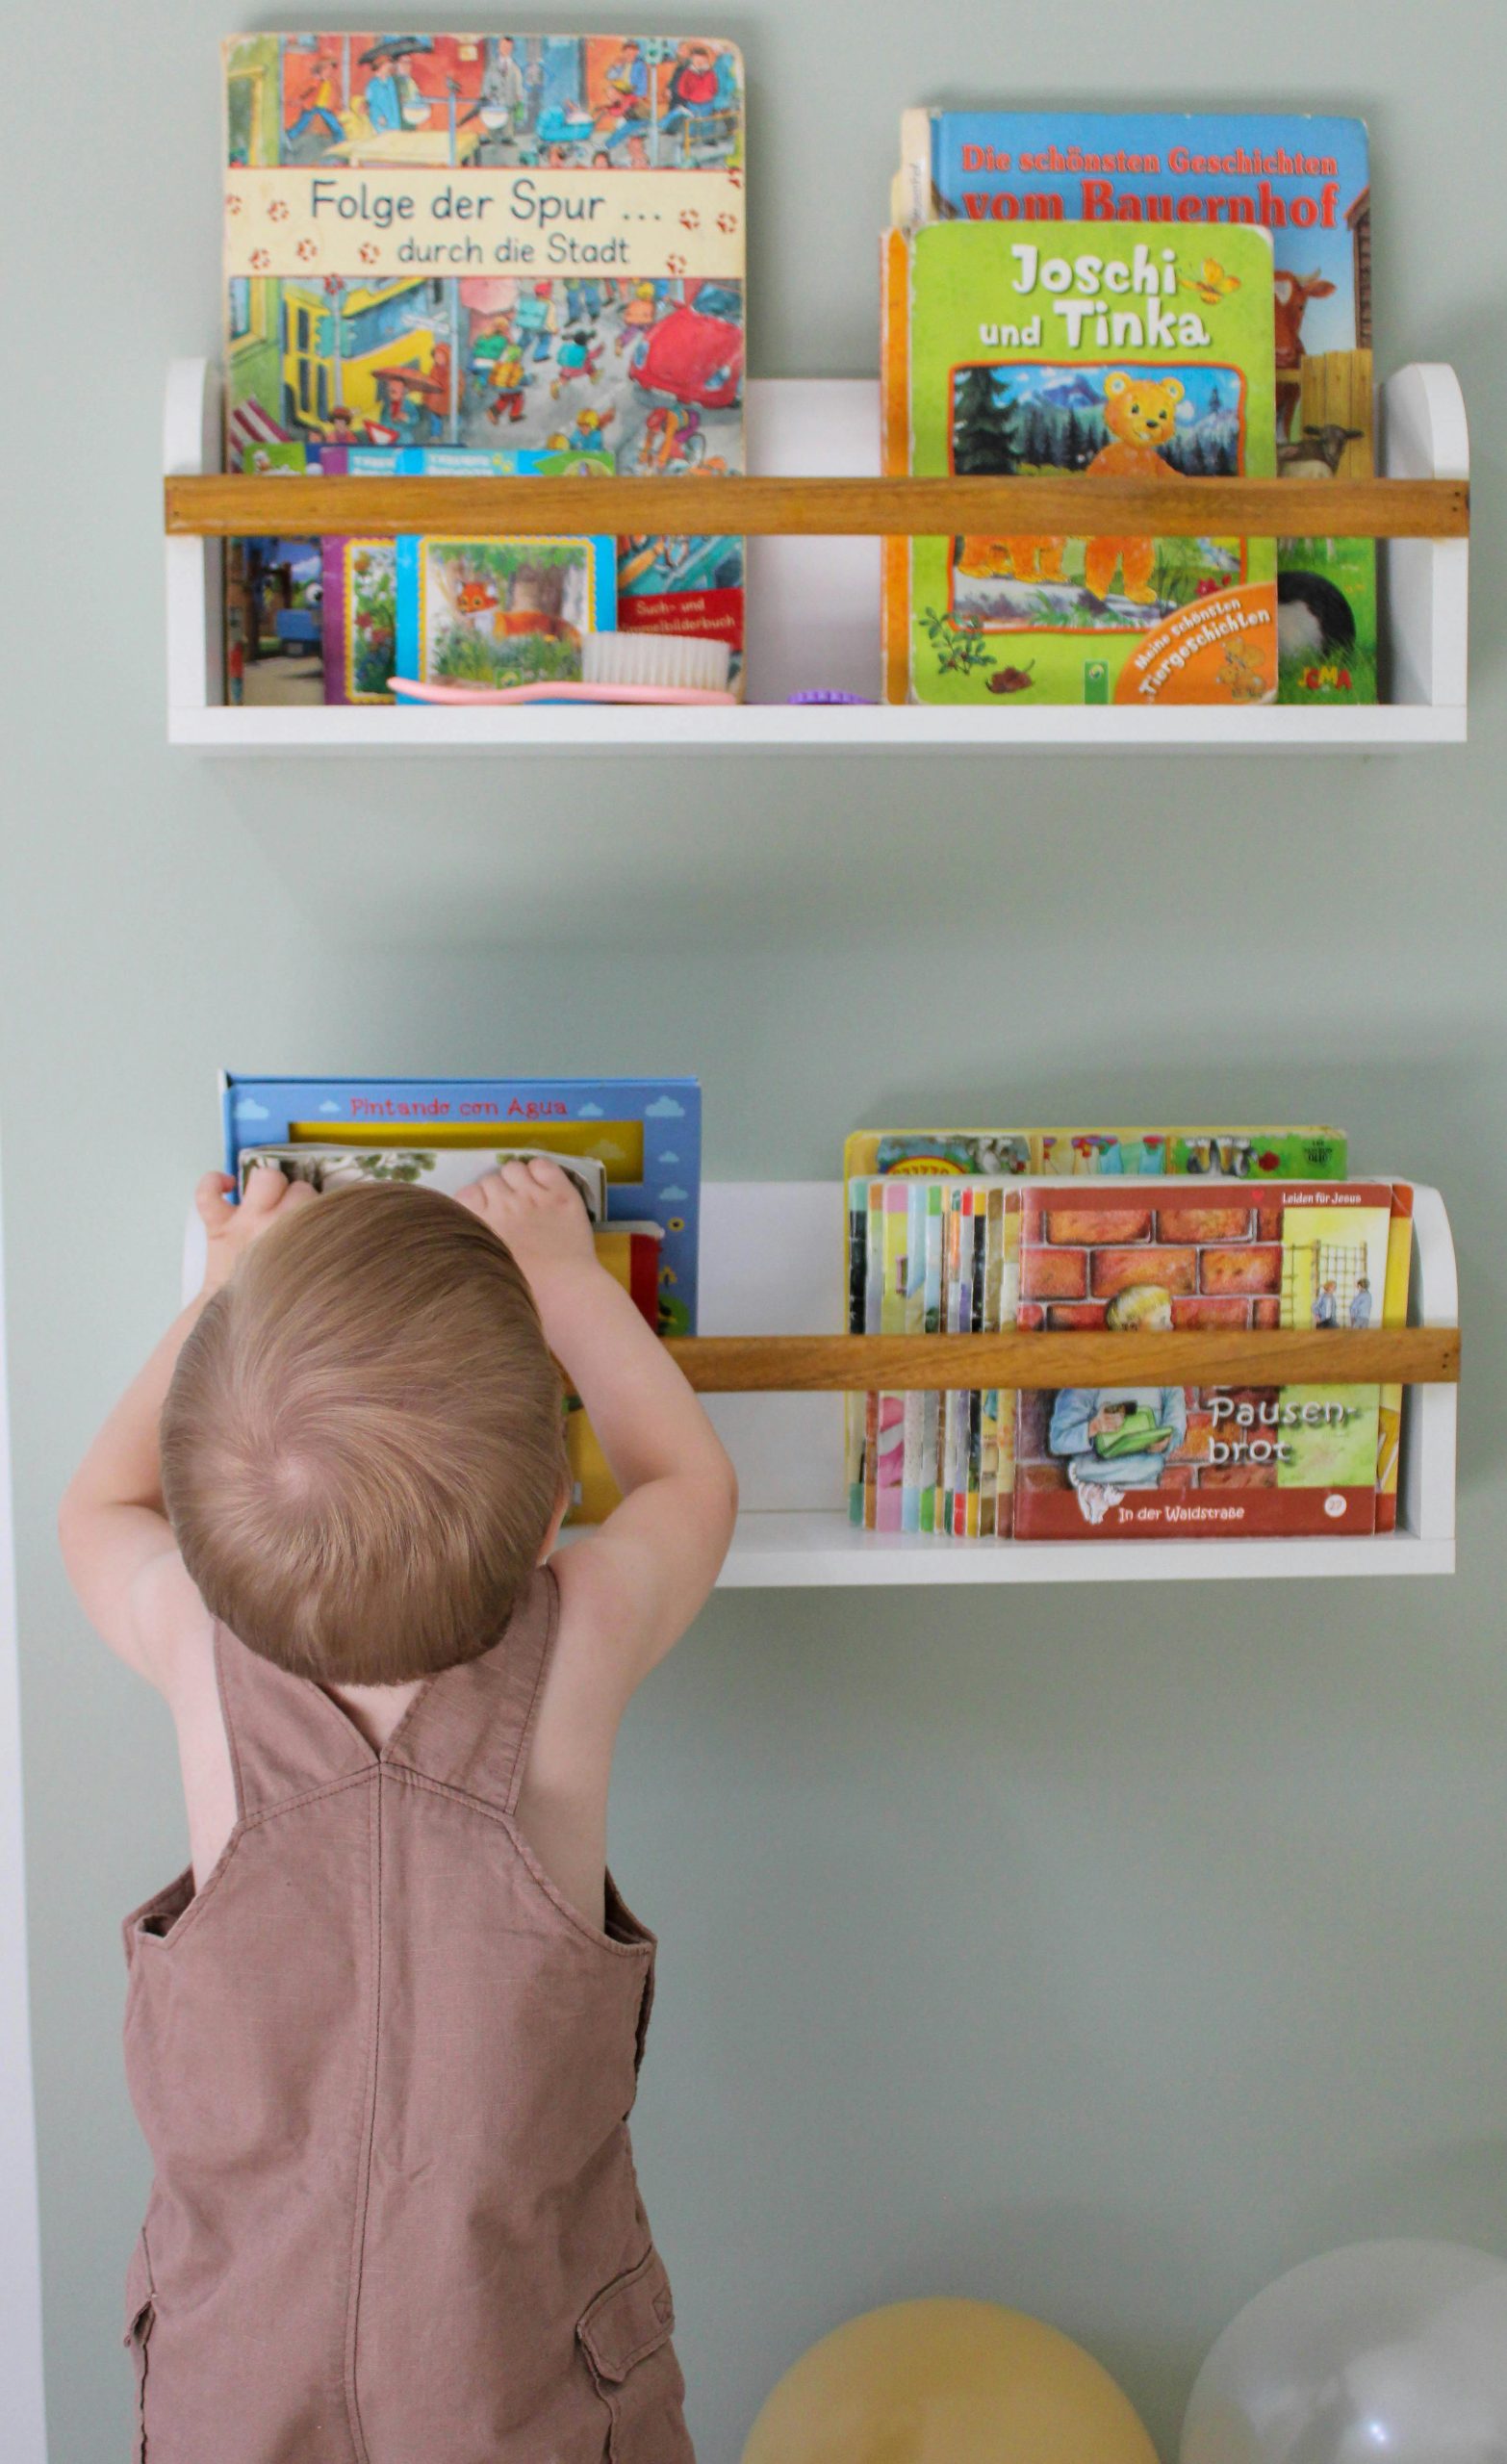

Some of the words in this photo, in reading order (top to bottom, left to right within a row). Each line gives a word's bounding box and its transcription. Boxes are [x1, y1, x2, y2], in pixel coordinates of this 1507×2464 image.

[961, 145, 1010, 172] Die
[1019, 145, 1161, 173] schönsten
[1167, 146, 1338, 175] Geschichten
[312, 179, 414, 227] Folge
[431, 186, 494, 219] der
[510, 178, 605, 227] Spur
[964, 192, 1064, 221] vom
[1081, 180, 1341, 228] Bauernhof
[397, 233, 482, 263] durch
[495, 233, 535, 263] die
[547, 234, 630, 264] Stadt
[1010, 244, 1179, 295] Joschi
[980, 316, 1041, 346] und
[1053, 296, 1211, 348] Tinka
[636, 600, 677, 616] Such-
[681, 597, 705, 613] und
[1135, 633, 1170, 671] Meine
[1170, 598, 1241, 636] schönsten
[1138, 609, 1270, 694] Tiergeschichten
[350, 1097, 450, 1116] Pintando
[459, 1100, 498, 1116] con
[507, 1097, 568, 1120] Agua
[1283, 1192, 1314, 1204] Leiden
[1315, 1192, 1330, 1204] für
[1332, 1193, 1362, 1204] Jesus
[1208, 1397, 1357, 1428] Pausen-
[1209, 1436, 1290, 1464] brot
[1118, 1506, 1134, 1524] In
[1137, 1506, 1162, 1521] der
[1164, 1504, 1245, 1523] Waldstraße
